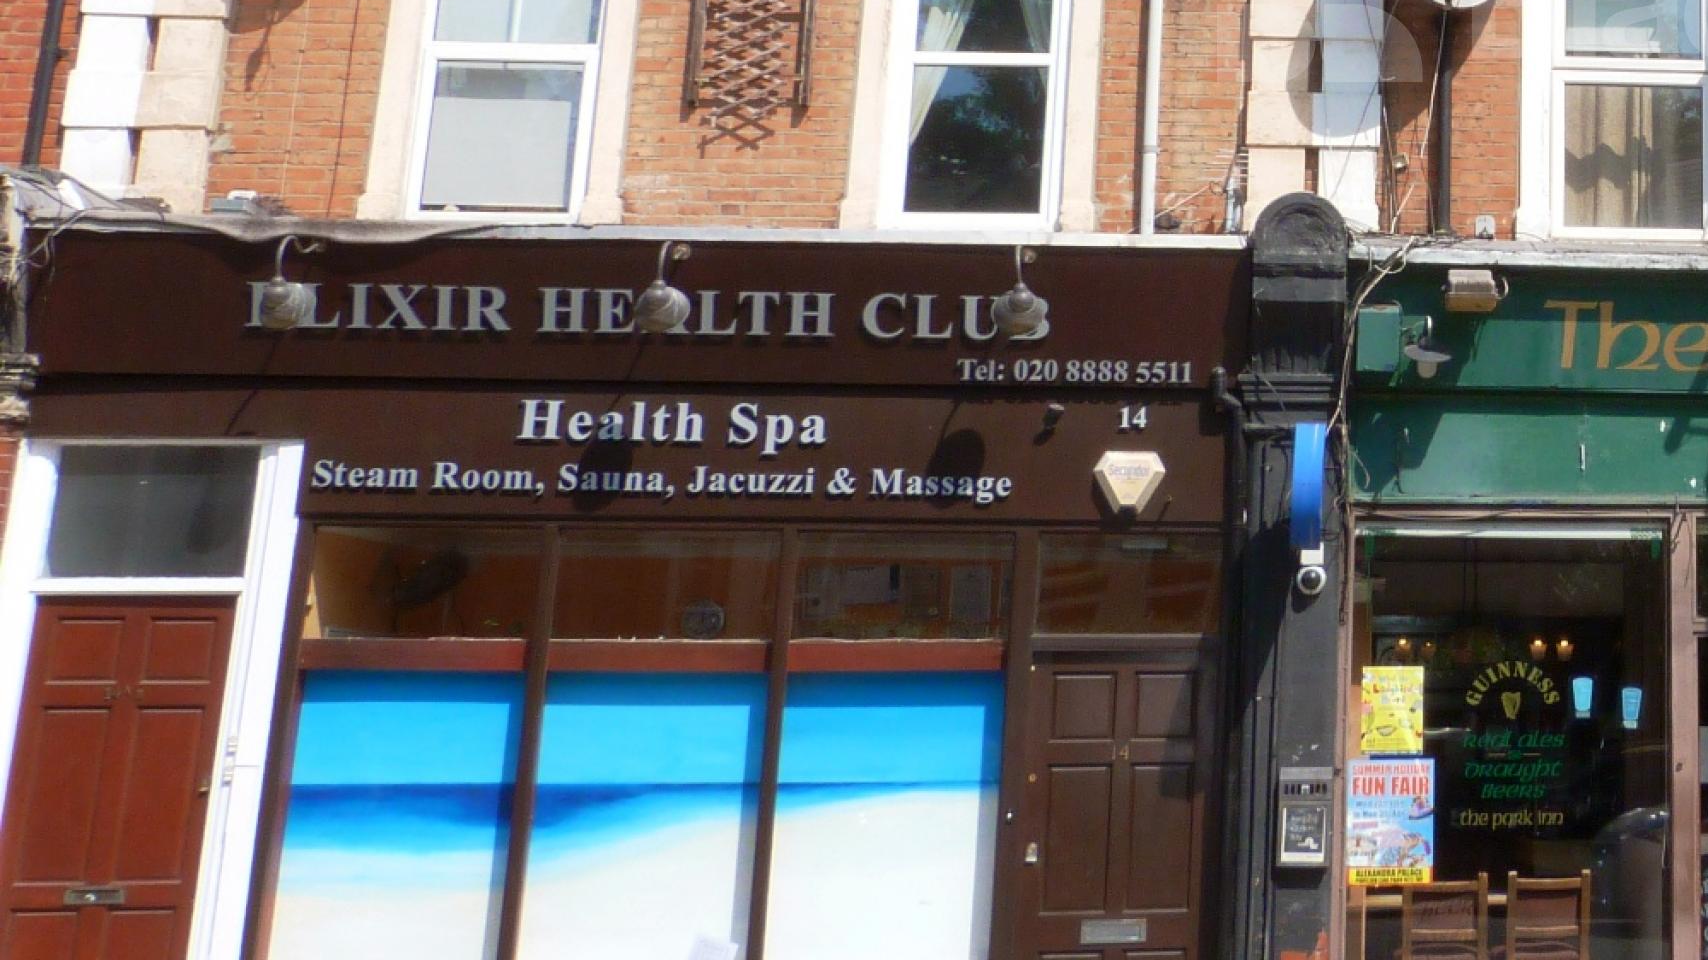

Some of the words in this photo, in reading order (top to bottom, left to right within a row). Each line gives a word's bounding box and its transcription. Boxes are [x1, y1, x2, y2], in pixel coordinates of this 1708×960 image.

[244, 281, 511, 332] LIXIR
[537, 287, 837, 338] HELTH
[956, 358, 1004, 383] Tel:
[1014, 359, 1058, 383] 020
[1065, 360, 1128, 384] 8888
[1135, 361, 1192, 385] 5511
[517, 398, 704, 442] Health
[727, 402, 827, 456] Spa
[1119, 405, 1147, 430] 14
[311, 459, 418, 489] Steam
[431, 461, 544, 495] Room,
[557, 463, 675, 498] Sauna,
[687, 466, 814, 496] Jacuzzi
[827, 468, 856, 496] &
[870, 468, 1013, 503] Massage
[1465, 660, 1560, 706] GUINNESS
[1352, 777, 1386, 796] FUN
[1391, 777, 1429, 796] FAIR
[1460, 808, 1488, 826] the
[1492, 808, 1533, 832] park
